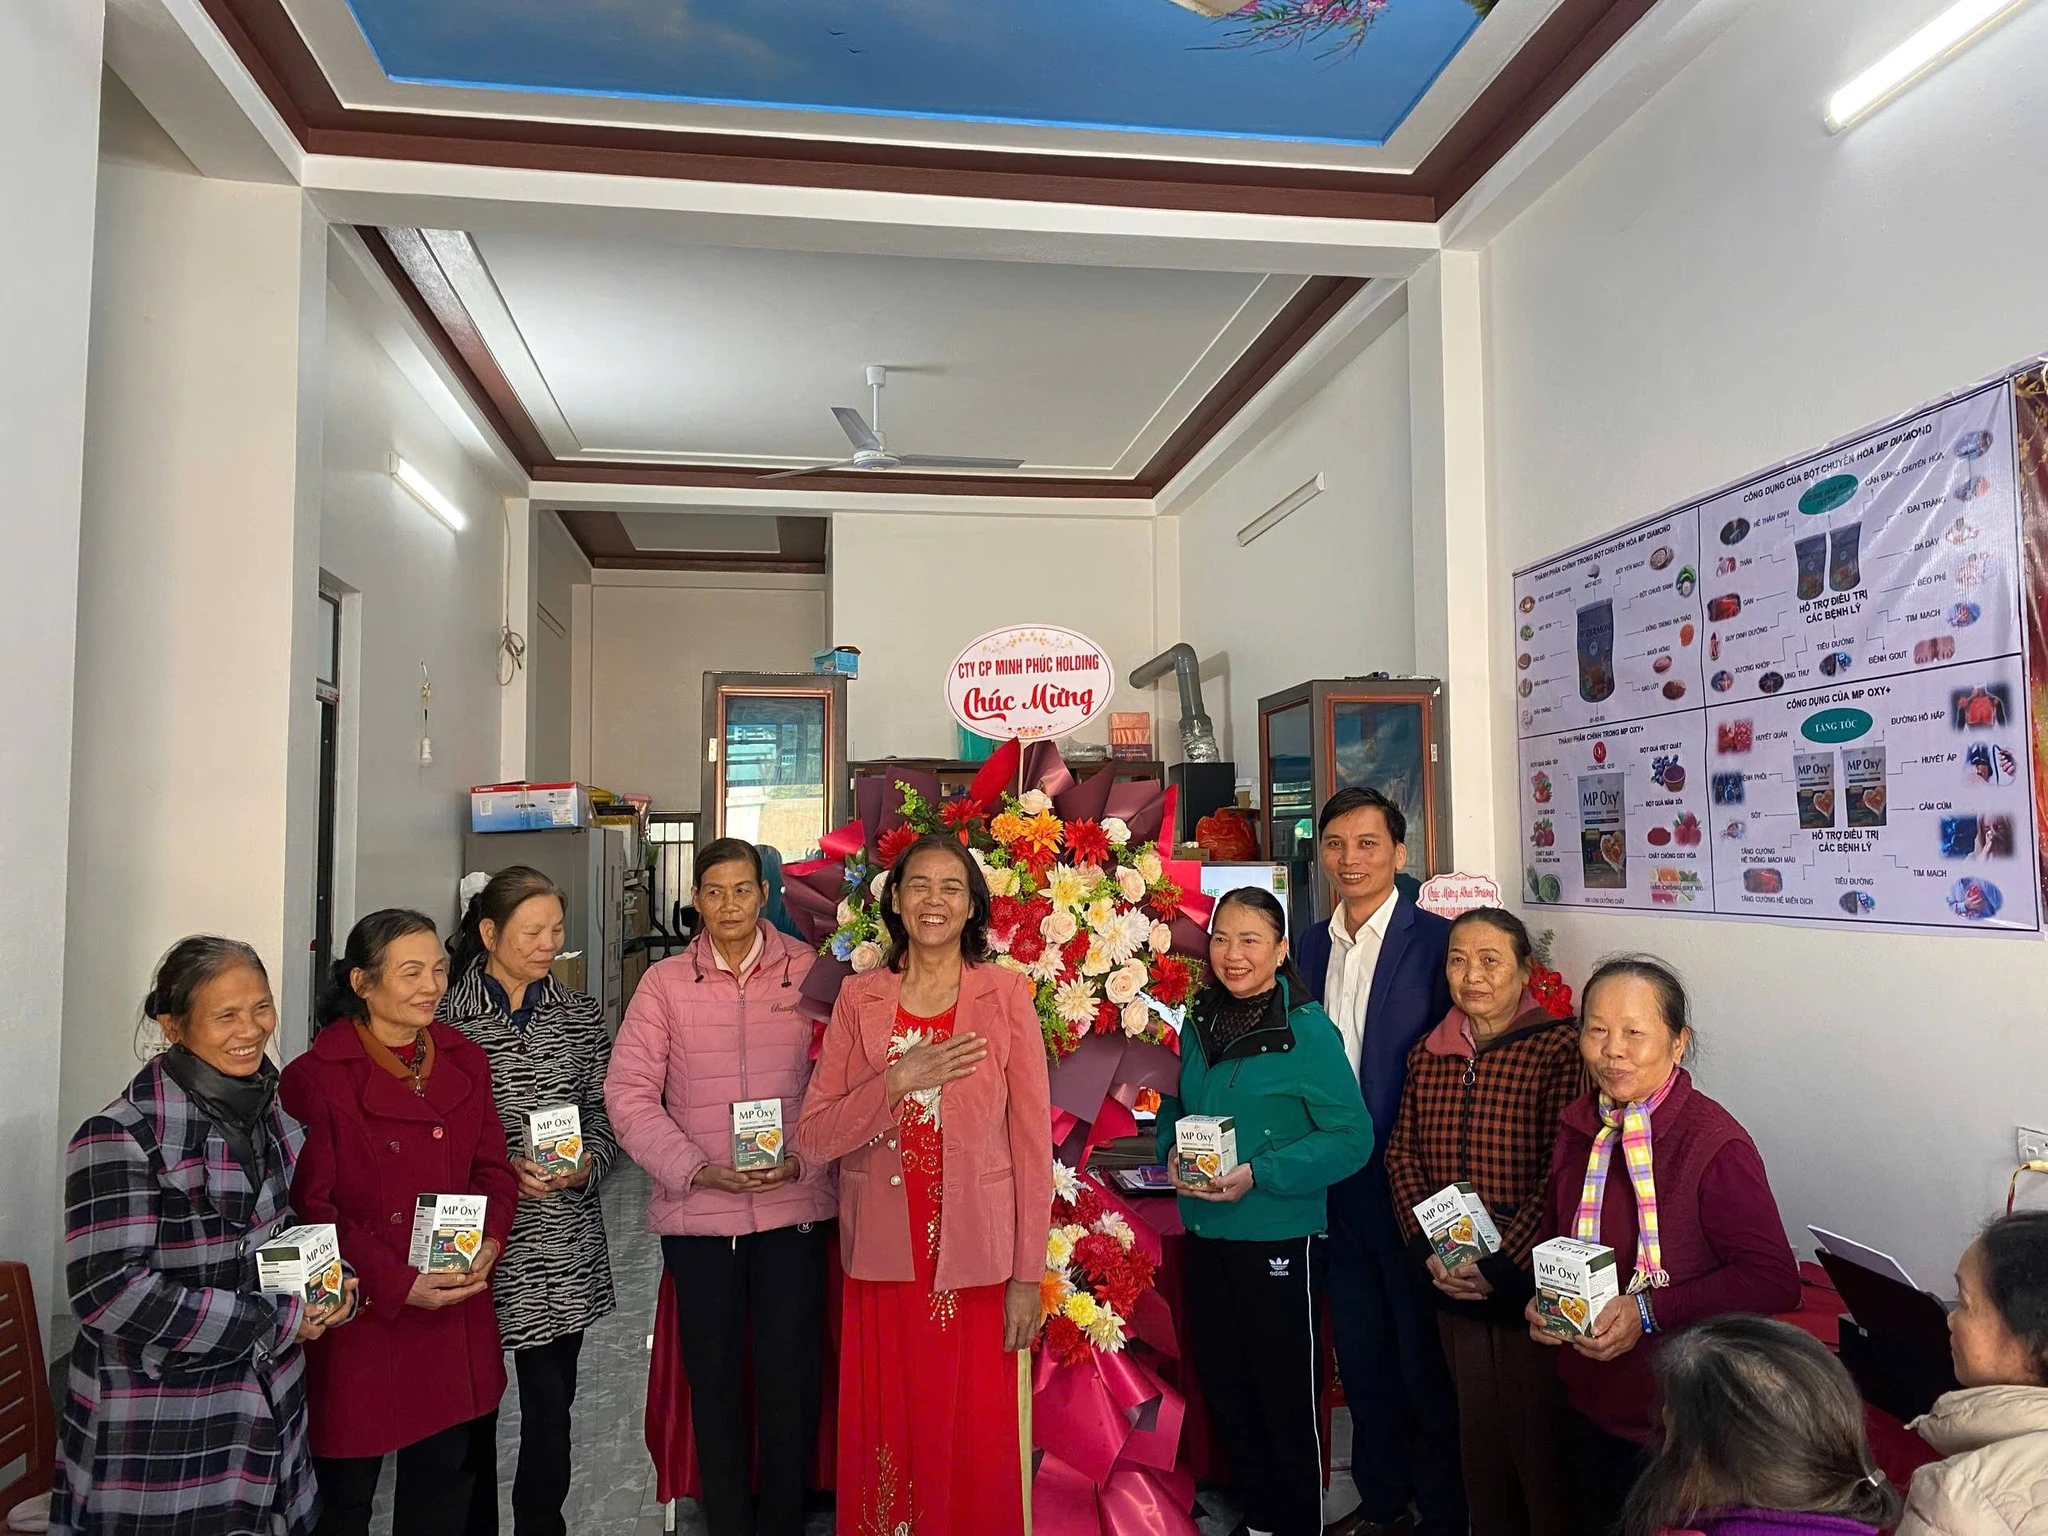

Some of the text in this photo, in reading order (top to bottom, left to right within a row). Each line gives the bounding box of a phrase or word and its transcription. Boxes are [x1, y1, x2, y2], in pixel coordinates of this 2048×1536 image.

[1743, 489, 1764, 503] CÔNG
[1764, 481, 1785, 497] DỤNG
[1786, 474, 1802, 490] CỦA
[1803, 467, 1821, 482] BỘT
[1876, 440, 1889, 454] MP
[1890, 423, 1932, 447] DIAMOND
[1577, 554, 1594, 566] TRONG
[1638, 533, 1646, 543] MP
[1647, 523, 1671, 540] DIAMOND
[1743, 597, 1754, 606] GAN
[1806, 613, 1823, 624] CÁC
[1905, 613, 1918, 622] TIM
[1888, 650, 1908, 661] GOUT
[958, 653, 1099, 679] CTY CP MINH PHÚC HOLDING
[1784, 671, 1797, 680] UNG
[963, 682, 1095, 723] Chúc Mừng
[1786, 685, 1891, 710] CÔNG DỤNG CỦA MP OXY+
[1602, 728, 1619, 739] TRONG
[1620, 727, 1629, 736] MP
[1629, 725, 1645, 735] OXY+
[1797, 764, 1811, 775] MP
[1847, 759, 1862, 771] MP
[1583, 791, 1598, 807] MP
[1818, 843, 1836, 853] CÁC
[1913, 869, 1925, 877] TIM
[739, 1110, 755, 1120] MP
[537, 1119, 553, 1131] MP
[1181, 1132, 1195, 1140] MP
[441, 1205, 458, 1216] MP
[1422, 1208, 1436, 1222] MP
[305, 1247, 319, 1264] MP
[1539, 1262, 1556, 1275] MP
